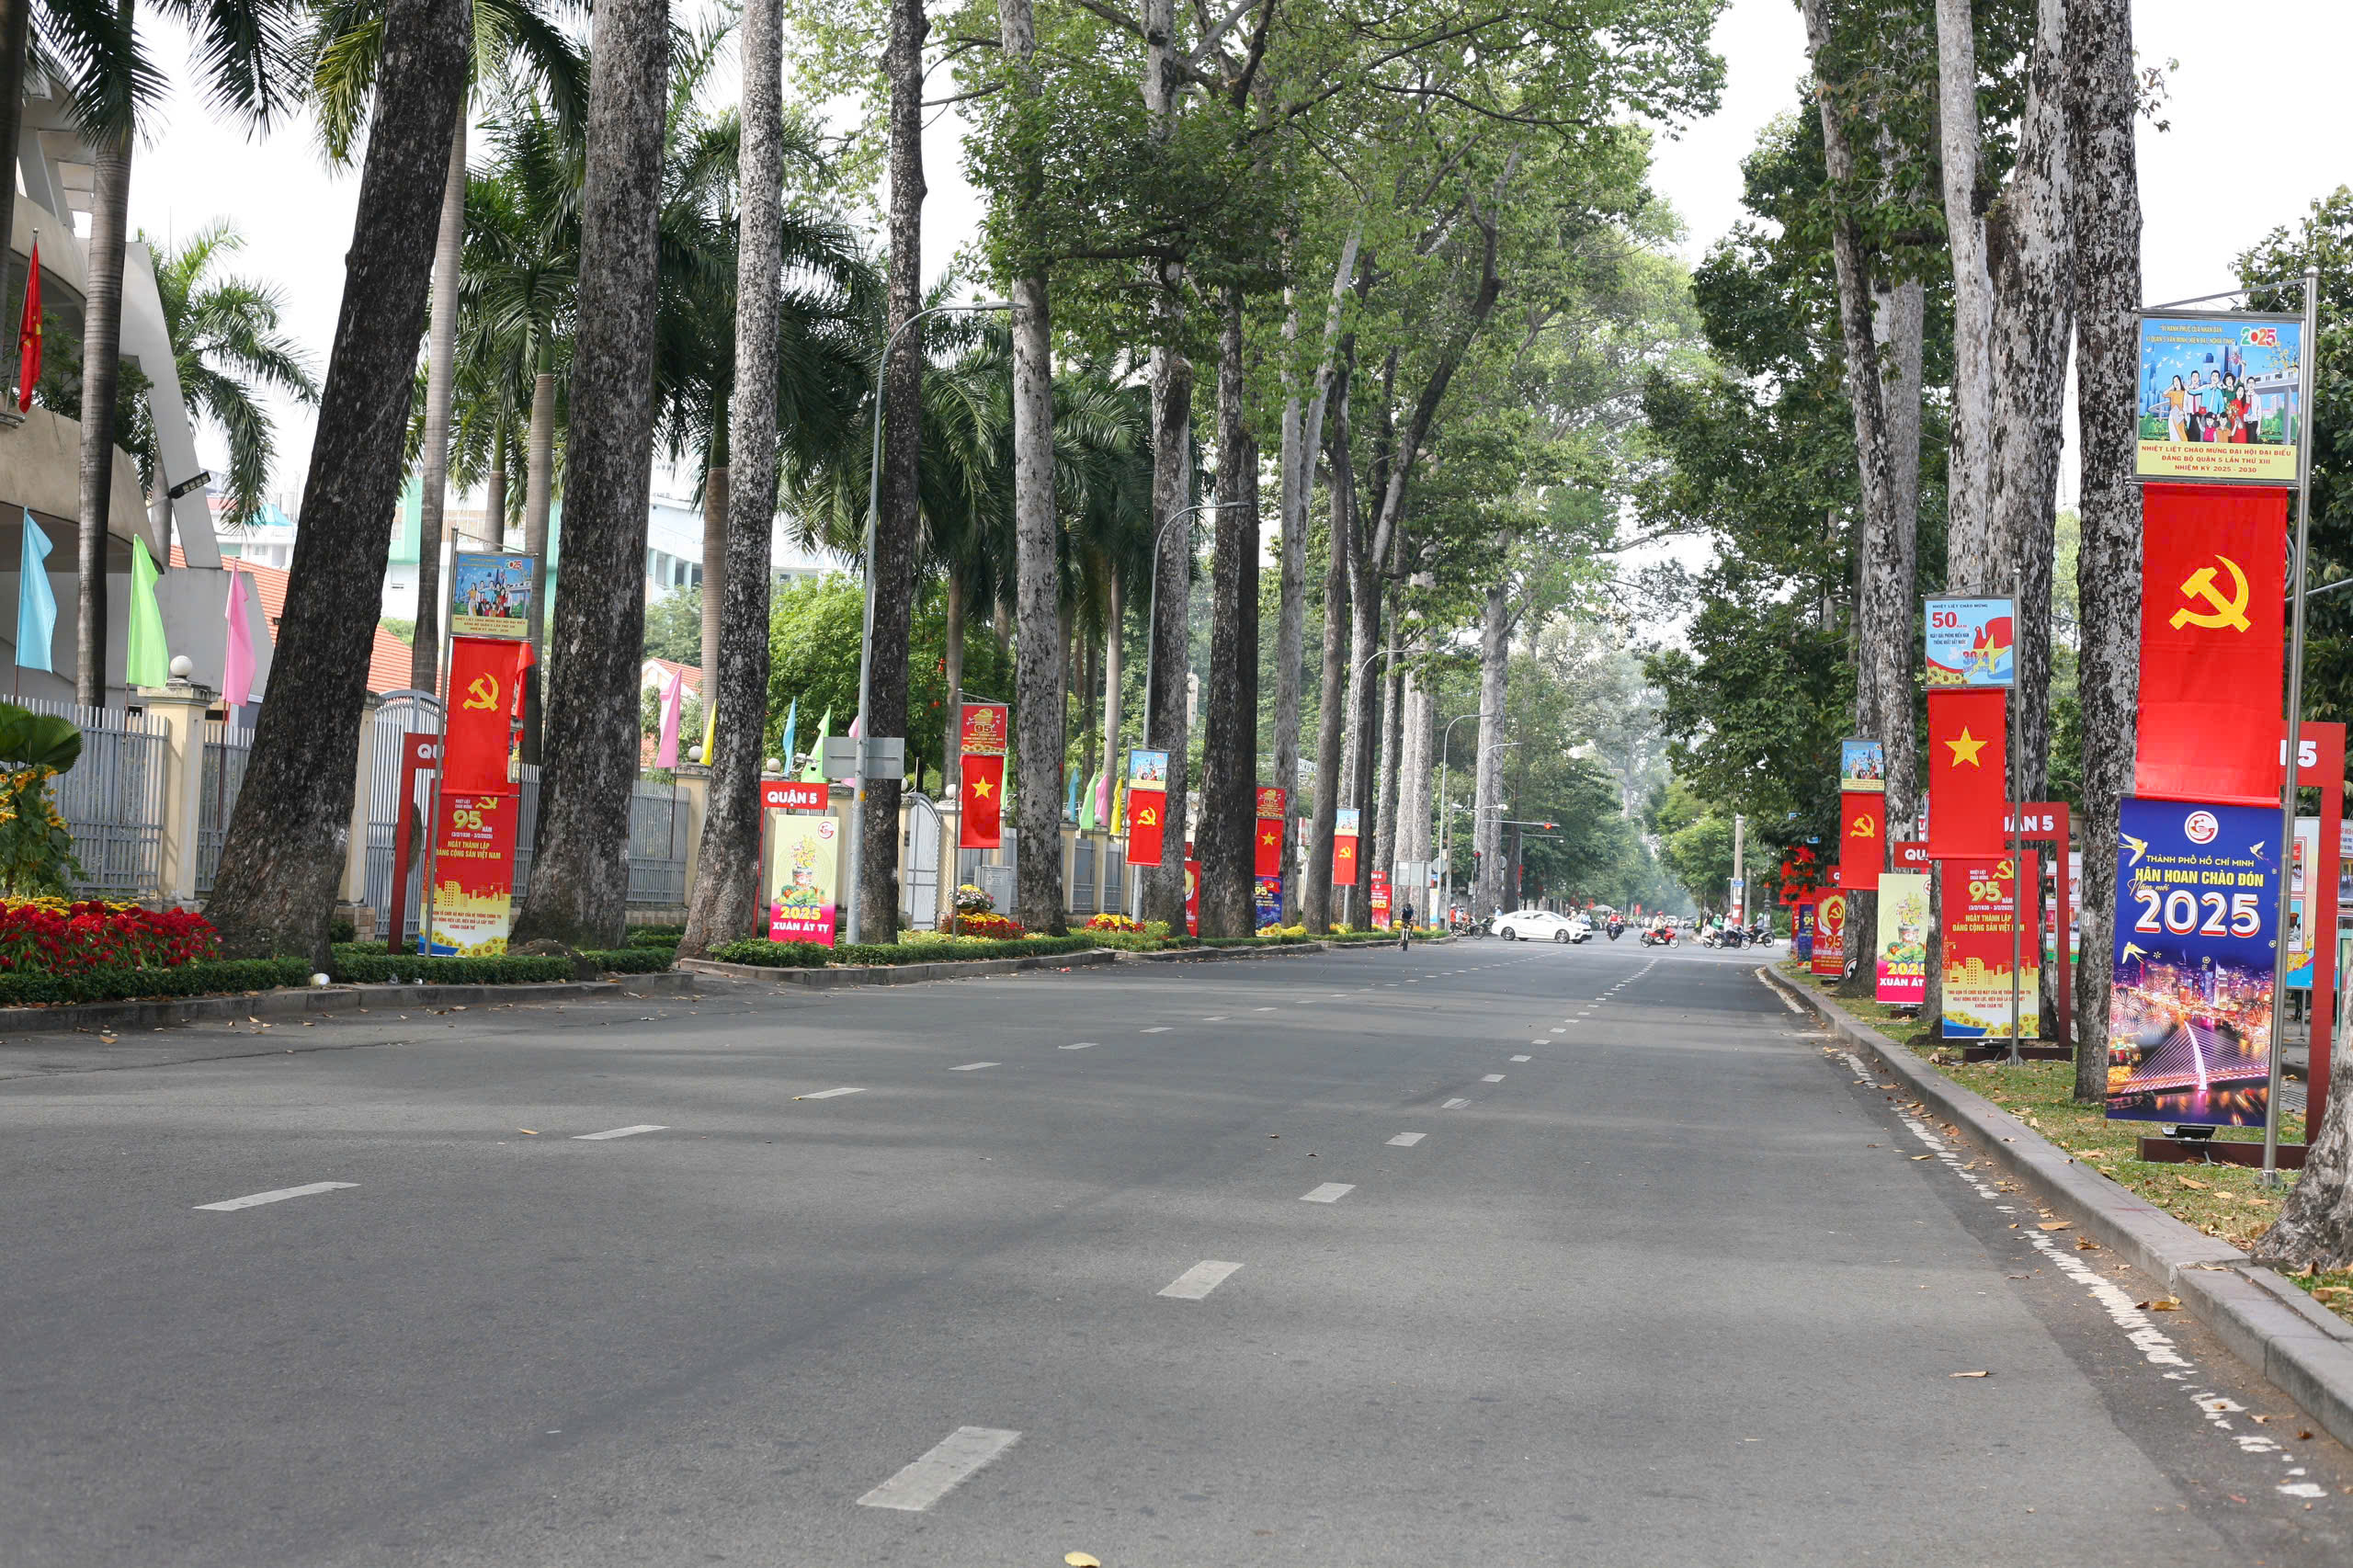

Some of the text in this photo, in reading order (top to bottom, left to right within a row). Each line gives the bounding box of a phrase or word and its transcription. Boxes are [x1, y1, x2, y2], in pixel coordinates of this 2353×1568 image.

[2241, 326, 2277, 347] 2025
[2274, 449, 2291, 457] BIỂU
[505, 560, 522, 570] 2025
[1932, 611, 1958, 628] 50
[974, 723, 993, 733] 95
[2298, 741, 2317, 767] 5
[767, 790, 817, 807] QUẬN 5
[453, 810, 483, 830] 95
[2042, 815, 2053, 831] 5
[2146, 854, 2176, 863] THÀNH
[2178, 855, 2197, 864] PHỐ
[2200, 855, 2212, 865] HỒ
[2215, 857, 2230, 866] CHÍ
[2135, 866, 2264, 887] HÂN HOAN CHÀO ĐÓN
[1255, 887, 1267, 895] 95
[1969, 881, 2002, 903] 95
[779, 905, 823, 920] 2025
[1965, 913, 1980, 922] NGÀY
[1982, 914, 2000, 922] THÀNH
[2134, 890, 2261, 937] 2025
[772, 921, 801, 930] XUÂN
[1825, 935, 1843, 949] 95
[1880, 977, 1908, 986] XUÂN
